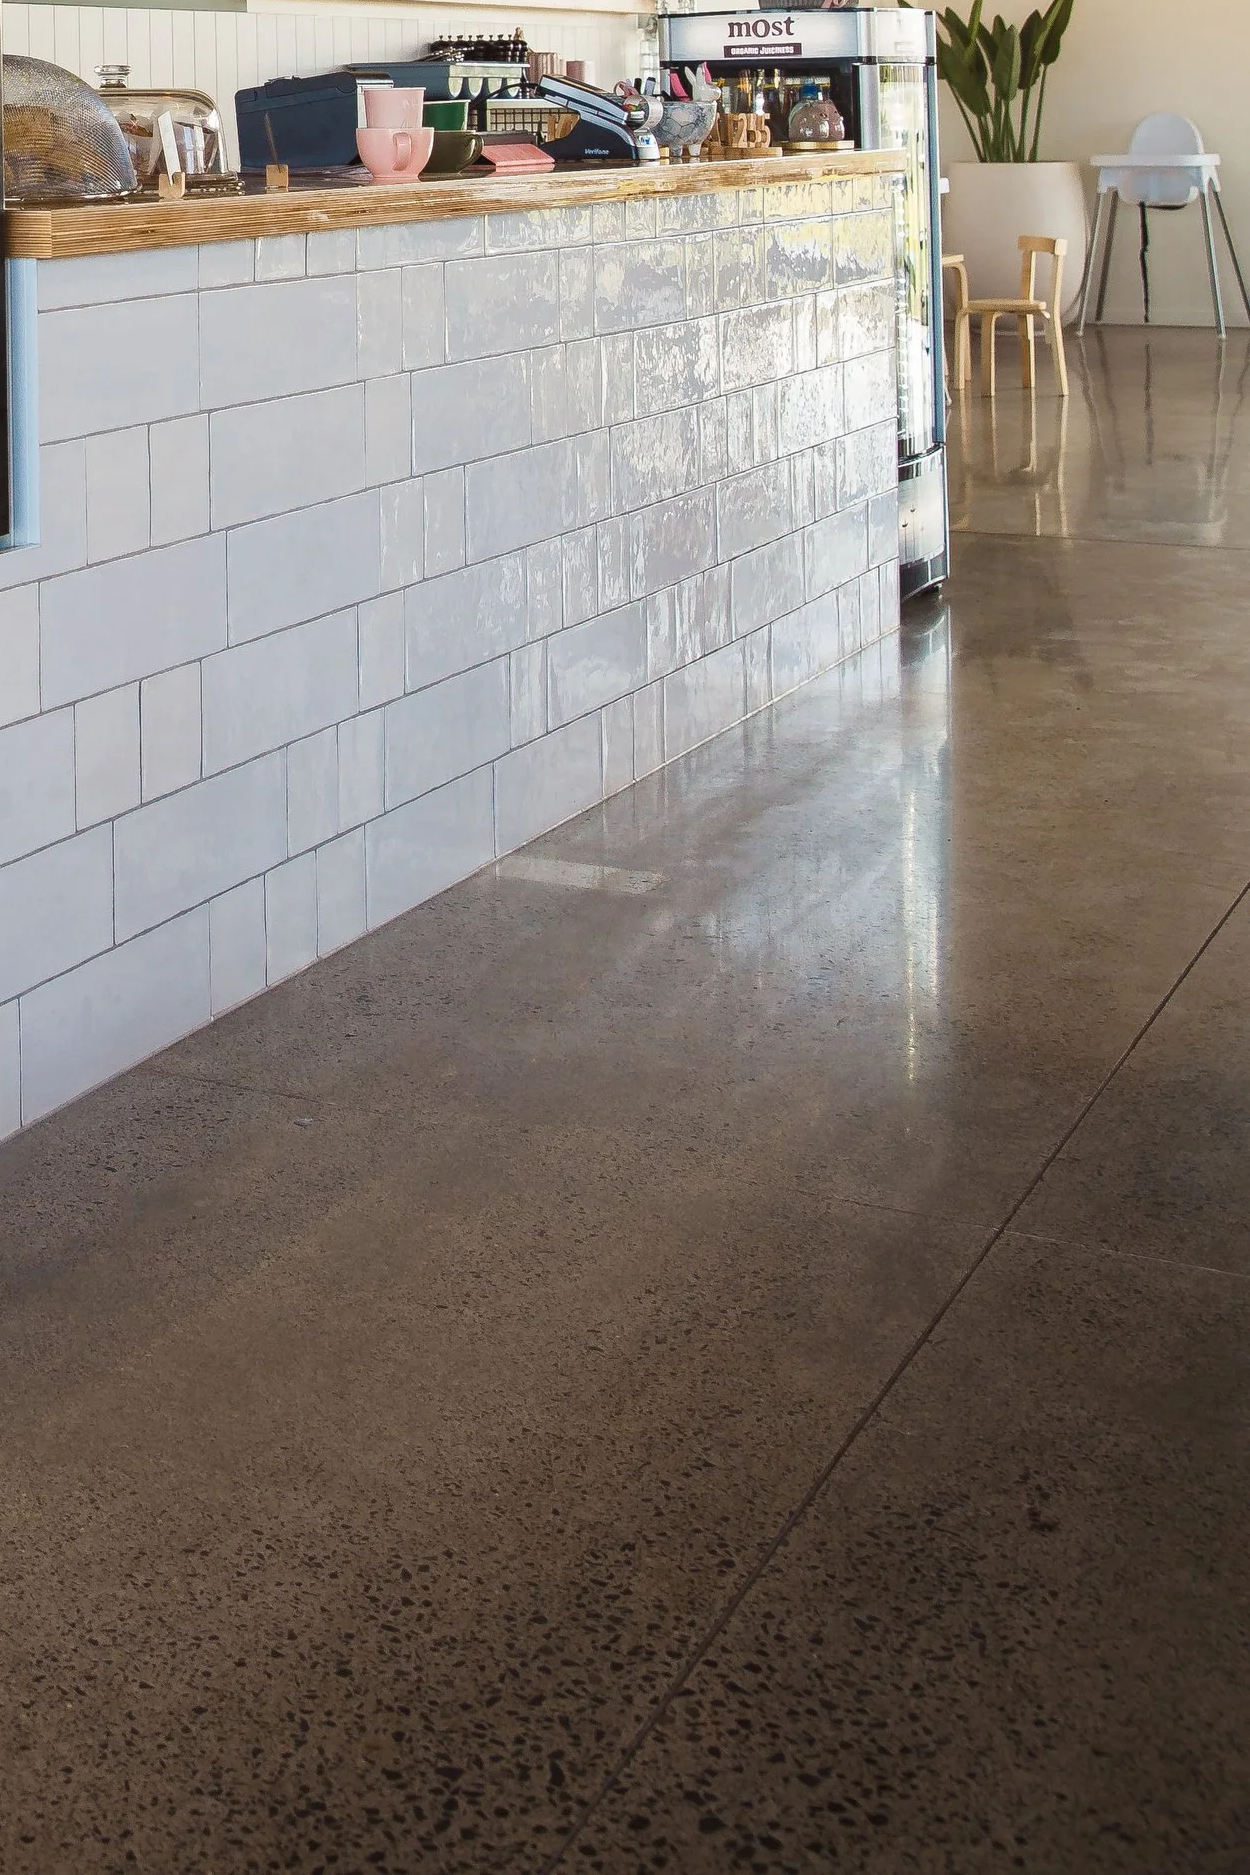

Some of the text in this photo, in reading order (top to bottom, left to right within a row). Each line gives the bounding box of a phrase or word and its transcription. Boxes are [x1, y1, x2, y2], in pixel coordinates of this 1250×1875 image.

[727, 16, 795, 39] most
[730, 47, 759, 56] ORGANIC
[584, 147, 610, 156] Verifone
